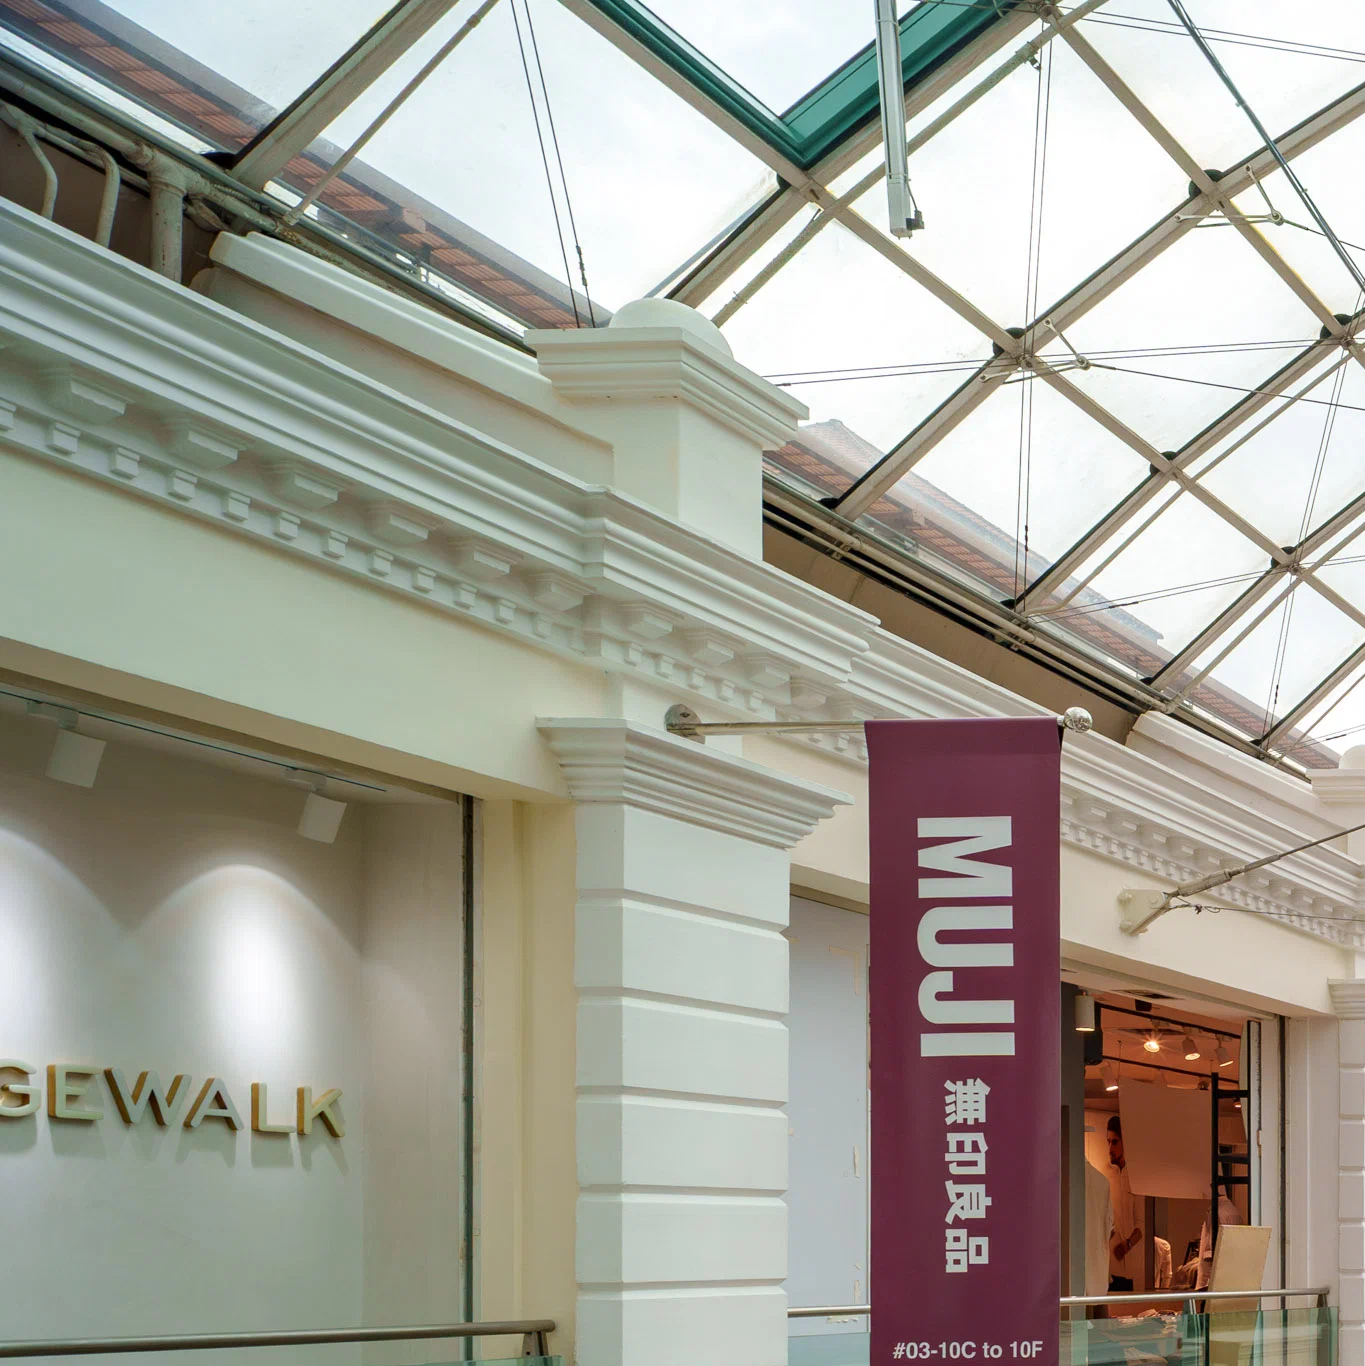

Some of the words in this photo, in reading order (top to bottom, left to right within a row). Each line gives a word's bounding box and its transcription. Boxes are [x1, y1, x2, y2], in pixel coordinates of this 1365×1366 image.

[916, 815, 1016, 1058] MUJI
[944, 1078, 993, 1274] 無印良品
[892, 1340, 976, 1362] #03-10C
[982, 1342, 1003, 1359] to
[1009, 1340, 1044, 1359] 10F
